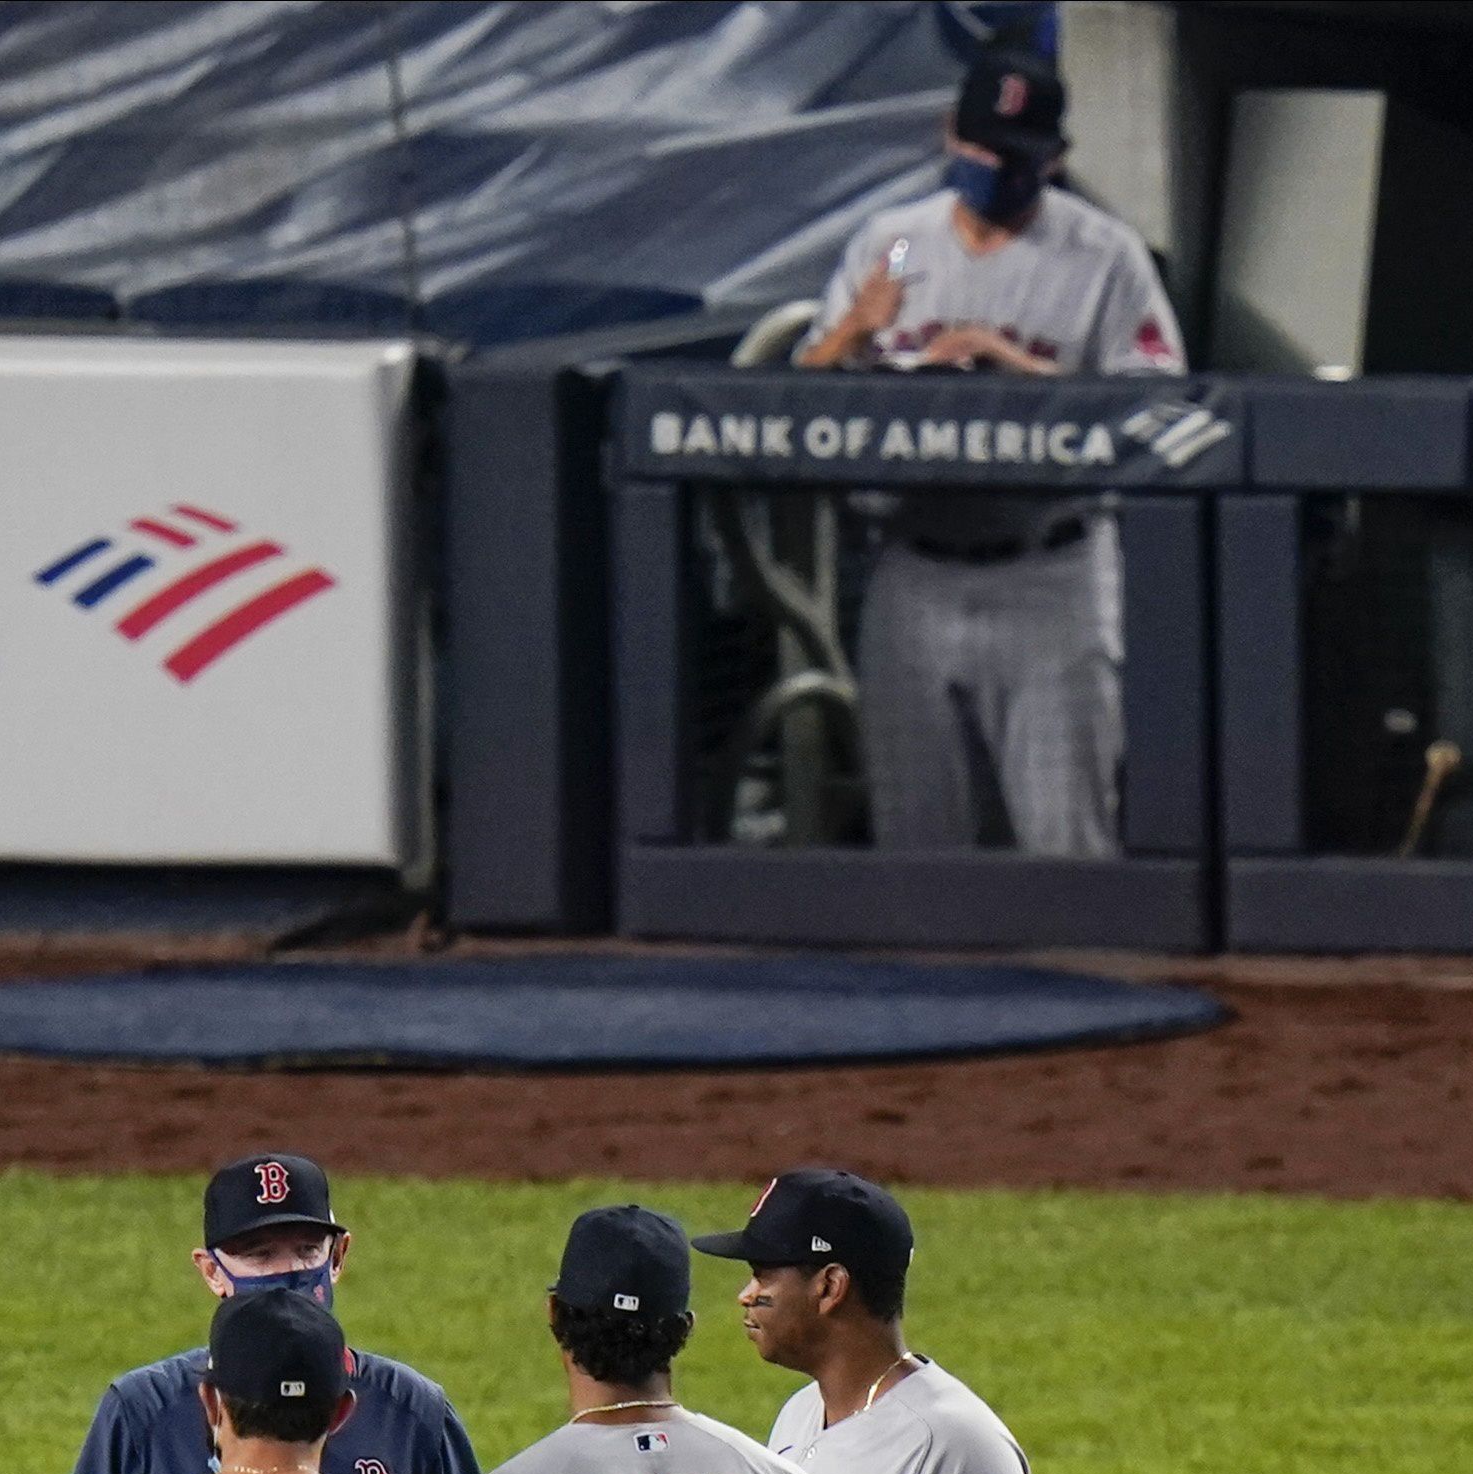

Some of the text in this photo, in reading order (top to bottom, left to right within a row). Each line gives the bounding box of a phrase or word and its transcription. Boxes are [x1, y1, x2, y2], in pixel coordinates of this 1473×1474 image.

[651, 412, 1116, 466] BANK OF AMERICA
[254, 1161, 290, 1204] B
